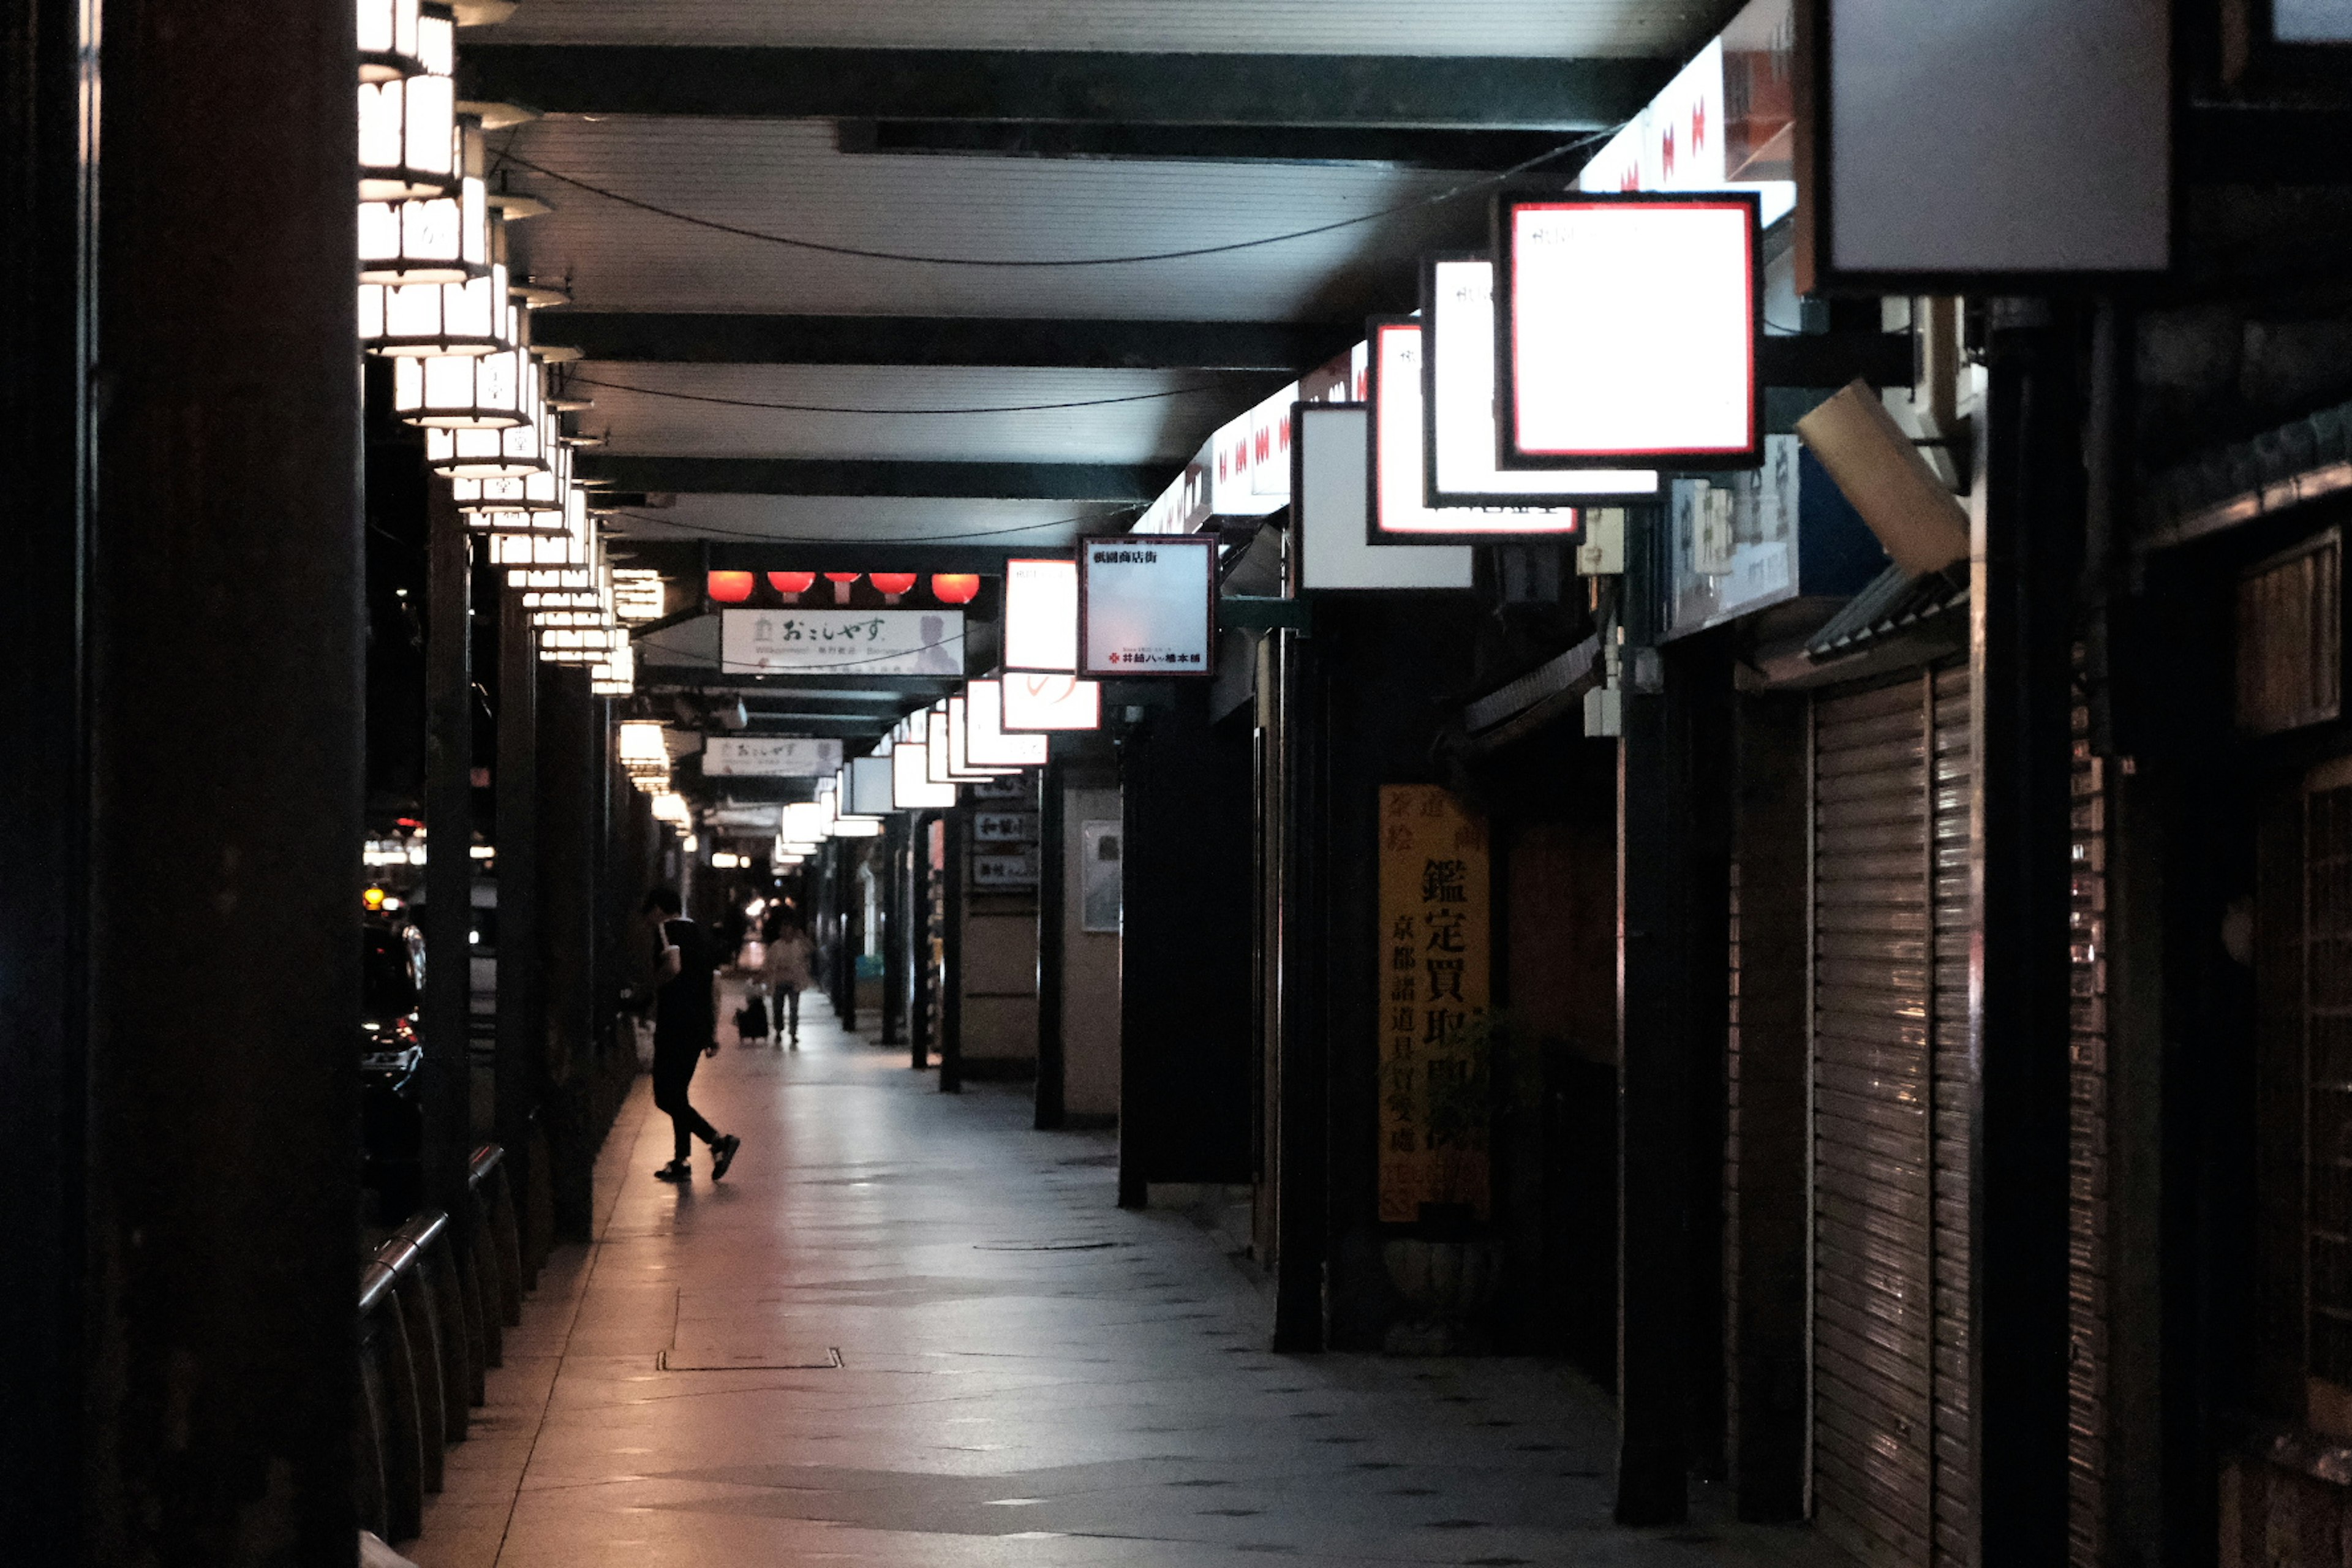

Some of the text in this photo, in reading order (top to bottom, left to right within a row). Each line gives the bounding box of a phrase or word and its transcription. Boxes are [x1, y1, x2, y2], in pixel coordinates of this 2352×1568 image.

[783, 616, 886, 641] おこしやす
